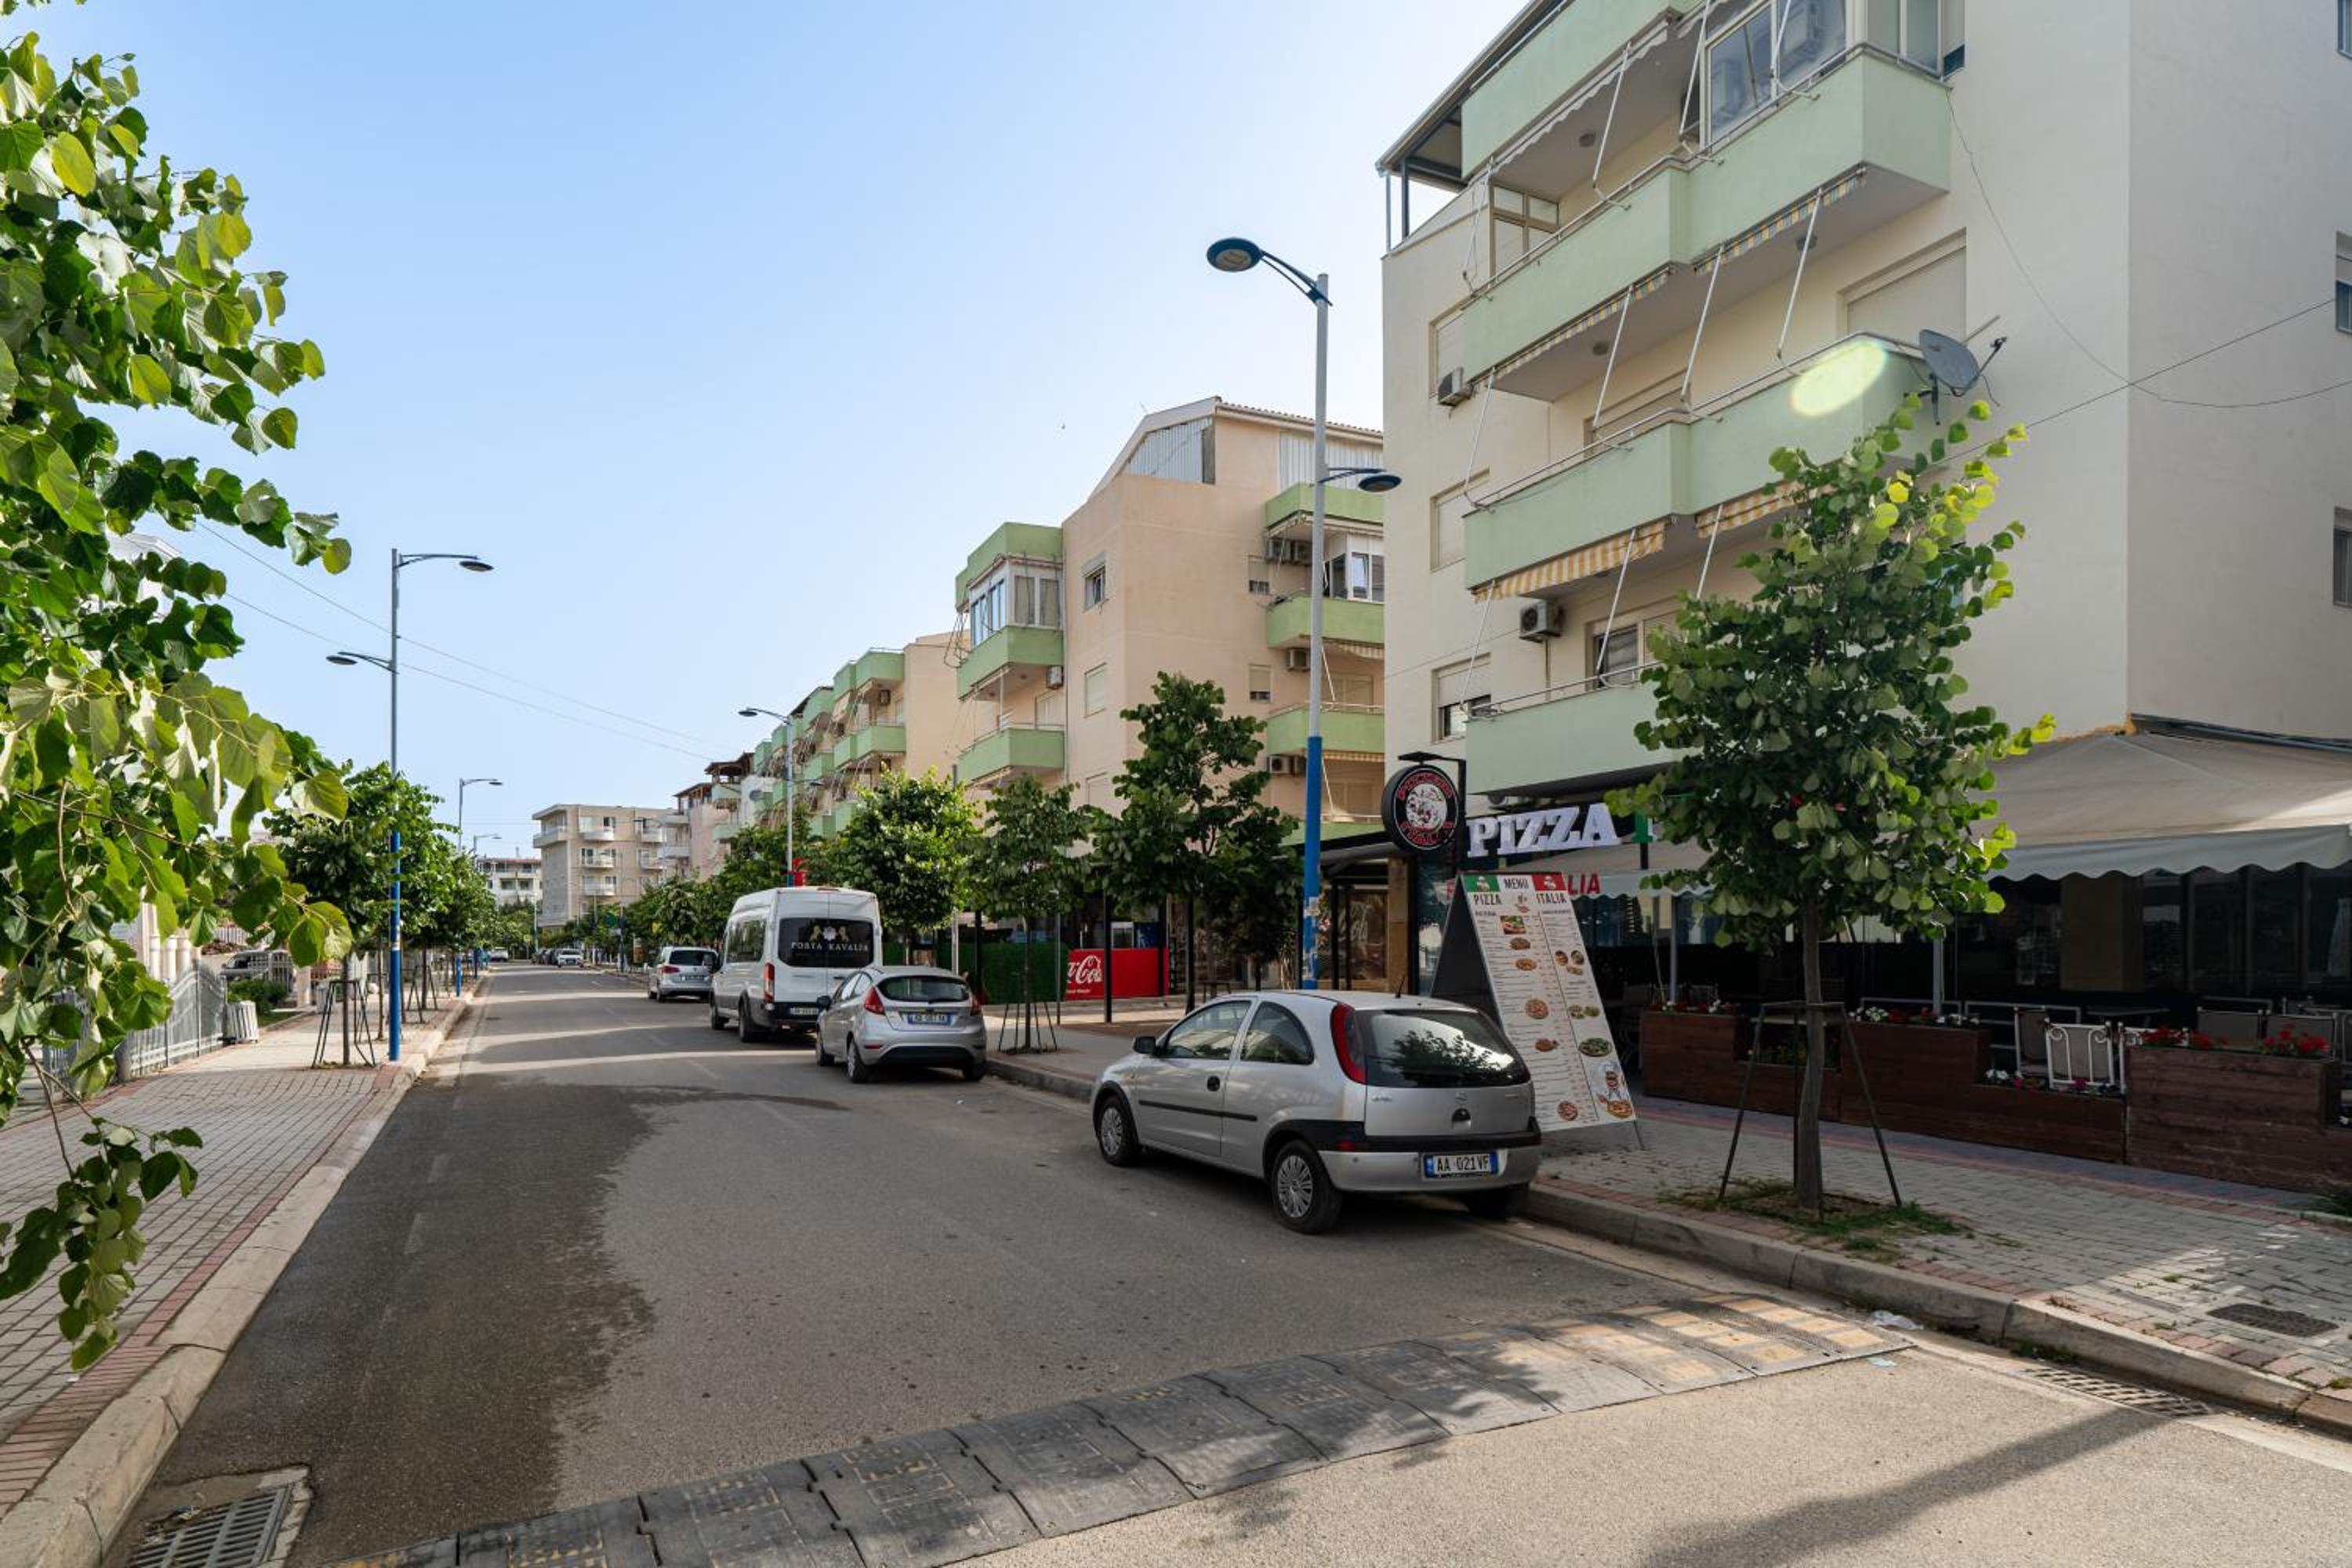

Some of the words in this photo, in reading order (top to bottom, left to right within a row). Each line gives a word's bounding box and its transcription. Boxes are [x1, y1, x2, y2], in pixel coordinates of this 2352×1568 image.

[1467, 803, 1621, 858] PIZZA
[1568, 873, 1600, 895] LIA
[1474, 893, 1502, 905] PIZZA
[1536, 892, 1567, 904] ITALIA
[1437, 1156, 1450, 1171] AA
